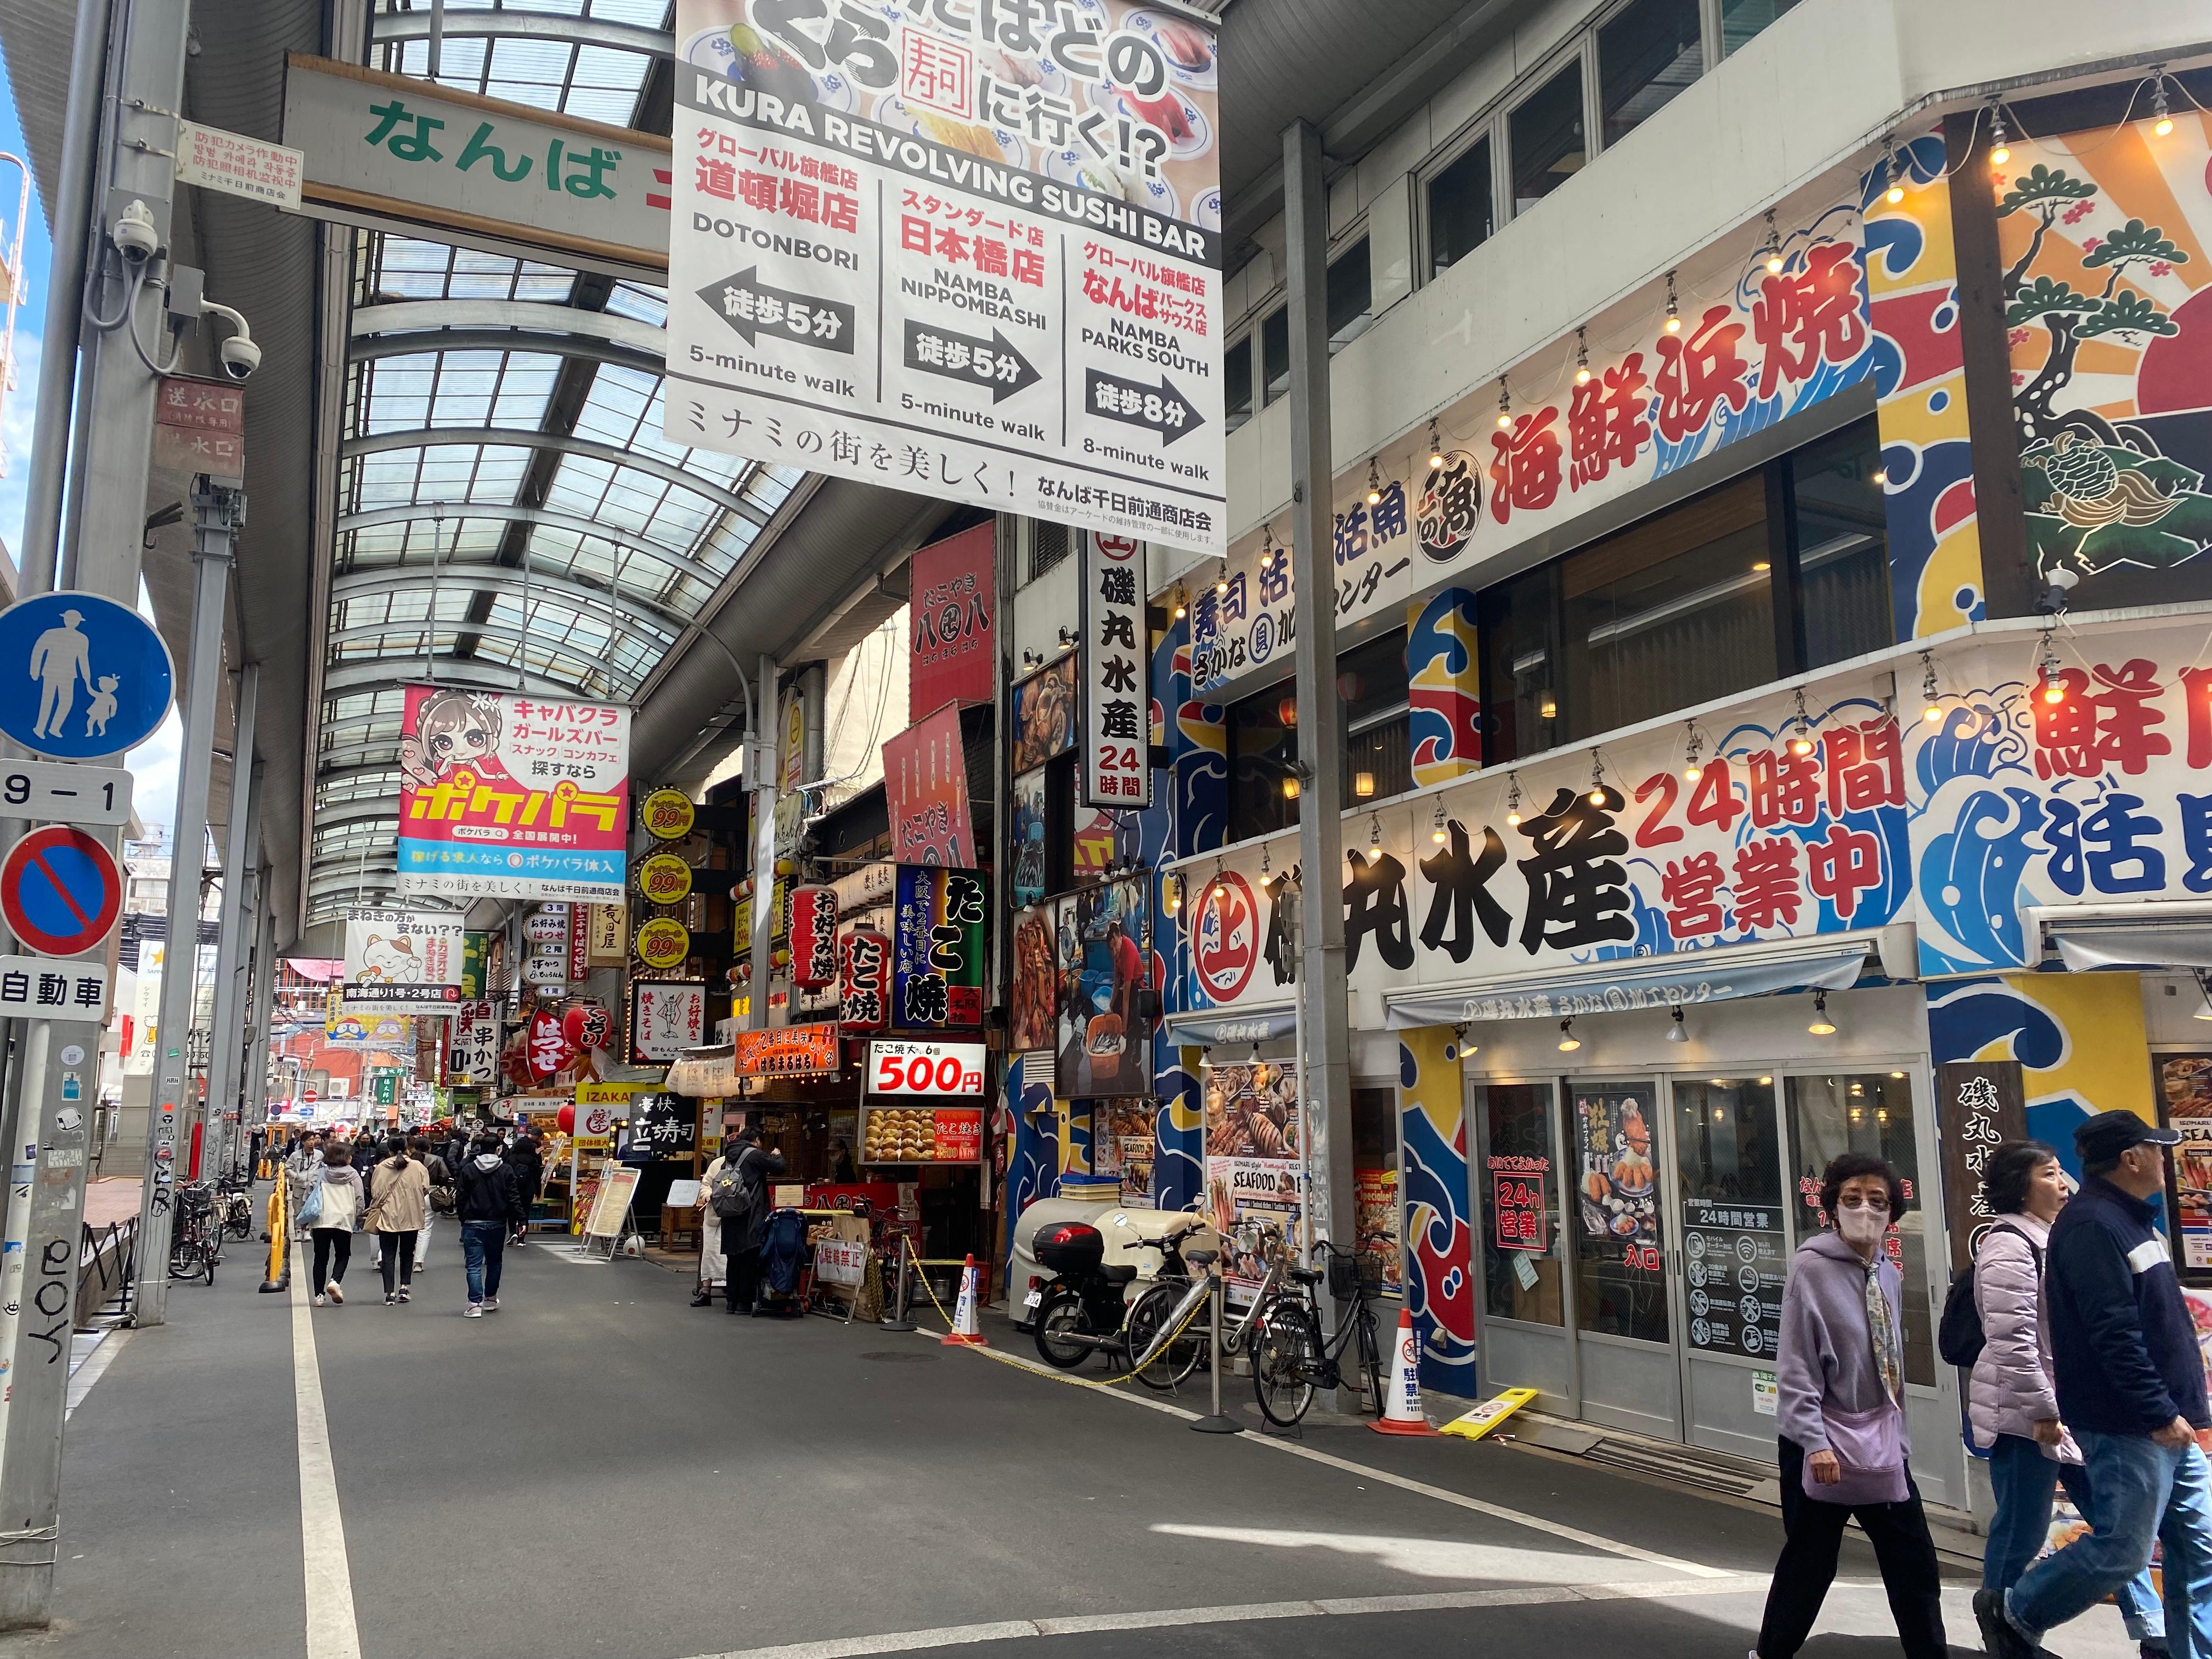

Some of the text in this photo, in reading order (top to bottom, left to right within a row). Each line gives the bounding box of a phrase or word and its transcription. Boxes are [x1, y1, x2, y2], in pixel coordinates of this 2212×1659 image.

[195, 131, 297, 166] 防犯カメラ作動中
[224, 151, 257, 168] 카메라
[364, 100, 622, 200] なんば
[696, 75, 1206, 259] KURA REVOLVING SUSHI BAR
[697, 127, 859, 191] グローバル旗艦店
[193, 155, 295, 189] 防犯照相机监视中
[201, 171, 285, 200] ミナミ千日前商店会
[696, 155, 859, 234] 道頓堀店
[902, 187, 1045, 247] スタンダード店
[693, 212, 859, 272] DOTONBORI
[902, 218, 1045, 287] 日本橋店
[934, 267, 1014, 305] NAMBA
[1084, 240, 1206, 297] グローバル旗艦店
[723, 286, 842, 341] 徒歩5分
[901, 276, 1047, 331] NIPPOMBASHI
[1082, 328, 1209, 377] PARKS SOUTH
[1111, 317, 1180, 352] NAMBA
[690, 345, 855, 399] 5-minute walk
[916, 332, 1022, 385] 徒歩5分
[167, 387, 239, 414] 送水口
[1491, 241, 1866, 525] 海鮮浜焼
[901, 393, 1046, 442] 5-minute walk
[1095, 380, 1187, 428] 徒歩8分
[686, 400, 1016, 497] ミナミの街を美しく！
[1084, 438, 1210, 481] 8-minute walk
[1037, 474, 1212, 532] なんば千日前通商店会
[1195, 571, 1247, 643] 寿司
[1335, 479, 1407, 566] 活魚
[1100, 567, 1138, 741] 磯丸水産
[514, 700, 618, 726] キャバクラ
[511, 744, 618, 763] スナック コンカフェ
[513, 723, 618, 746] ガールズバー
[531, 760, 596, 778] 探すなら
[1099, 745, 1140, 771] 24
[409, 771, 620, 832] ポケパラ
[1099, 775, 1140, 798] 時間
[1635, 715, 1905, 849] 24時間
[651, 807, 691, 828] 99円
[541, 884, 619, 896] なんば千日前通商店会
[648, 873, 688, 893] 99円
[1661, 826, 1881, 939] 営業中
[348, 910, 415, 922] まねきの方が
[531, 919, 566, 929] お好み焼
[534, 930, 565, 940] はつせ
[915, 871, 932, 965] 大阪で2番目に
[645, 937, 686, 957] 99円
[812, 892, 836, 980] お好み焼
[897, 905, 915, 973] 美味しい店
[905, 876, 985, 1023] たこ焼
[1, 969, 103, 1009] 自動車
[848, 936, 881, 1020] たこ焼
[640, 991, 654, 1041] 焼きそば
[687, 993, 702, 1041] お好焼き
[473, 1026, 494, 1079] 串かつ
[531, 1018, 564, 1070] はつせ
[874, 1043, 905, 1054] たこ焼
[878, 1057, 982, 1093] 500円
[638, 1096, 676, 1113] 豪快
[633, 1116, 695, 1143] 立ち寿司
[936, 1121, 981, 1136] たこ焼き
[1587, 1098, 1610, 1153] 牡蠣
[1124, 1143, 1145, 1153] SEAFOOD
[1487, 1156, 1549, 1172] あいててよかった
[1234, 1171, 1276, 1191] SEAFOOD
[1499, 1182, 1539, 1209] 24h
[1688, 1198, 1713, 1207] 営業時間
[1700, 1209, 1769, 1228] 24時間営業
[1500, 1210, 1537, 1240] 営業
[824, 1246, 860, 1268] 駐輪禁止
[1625, 1244, 1660, 1270] 入口
[1404, 1368, 1419, 1381] 駐
